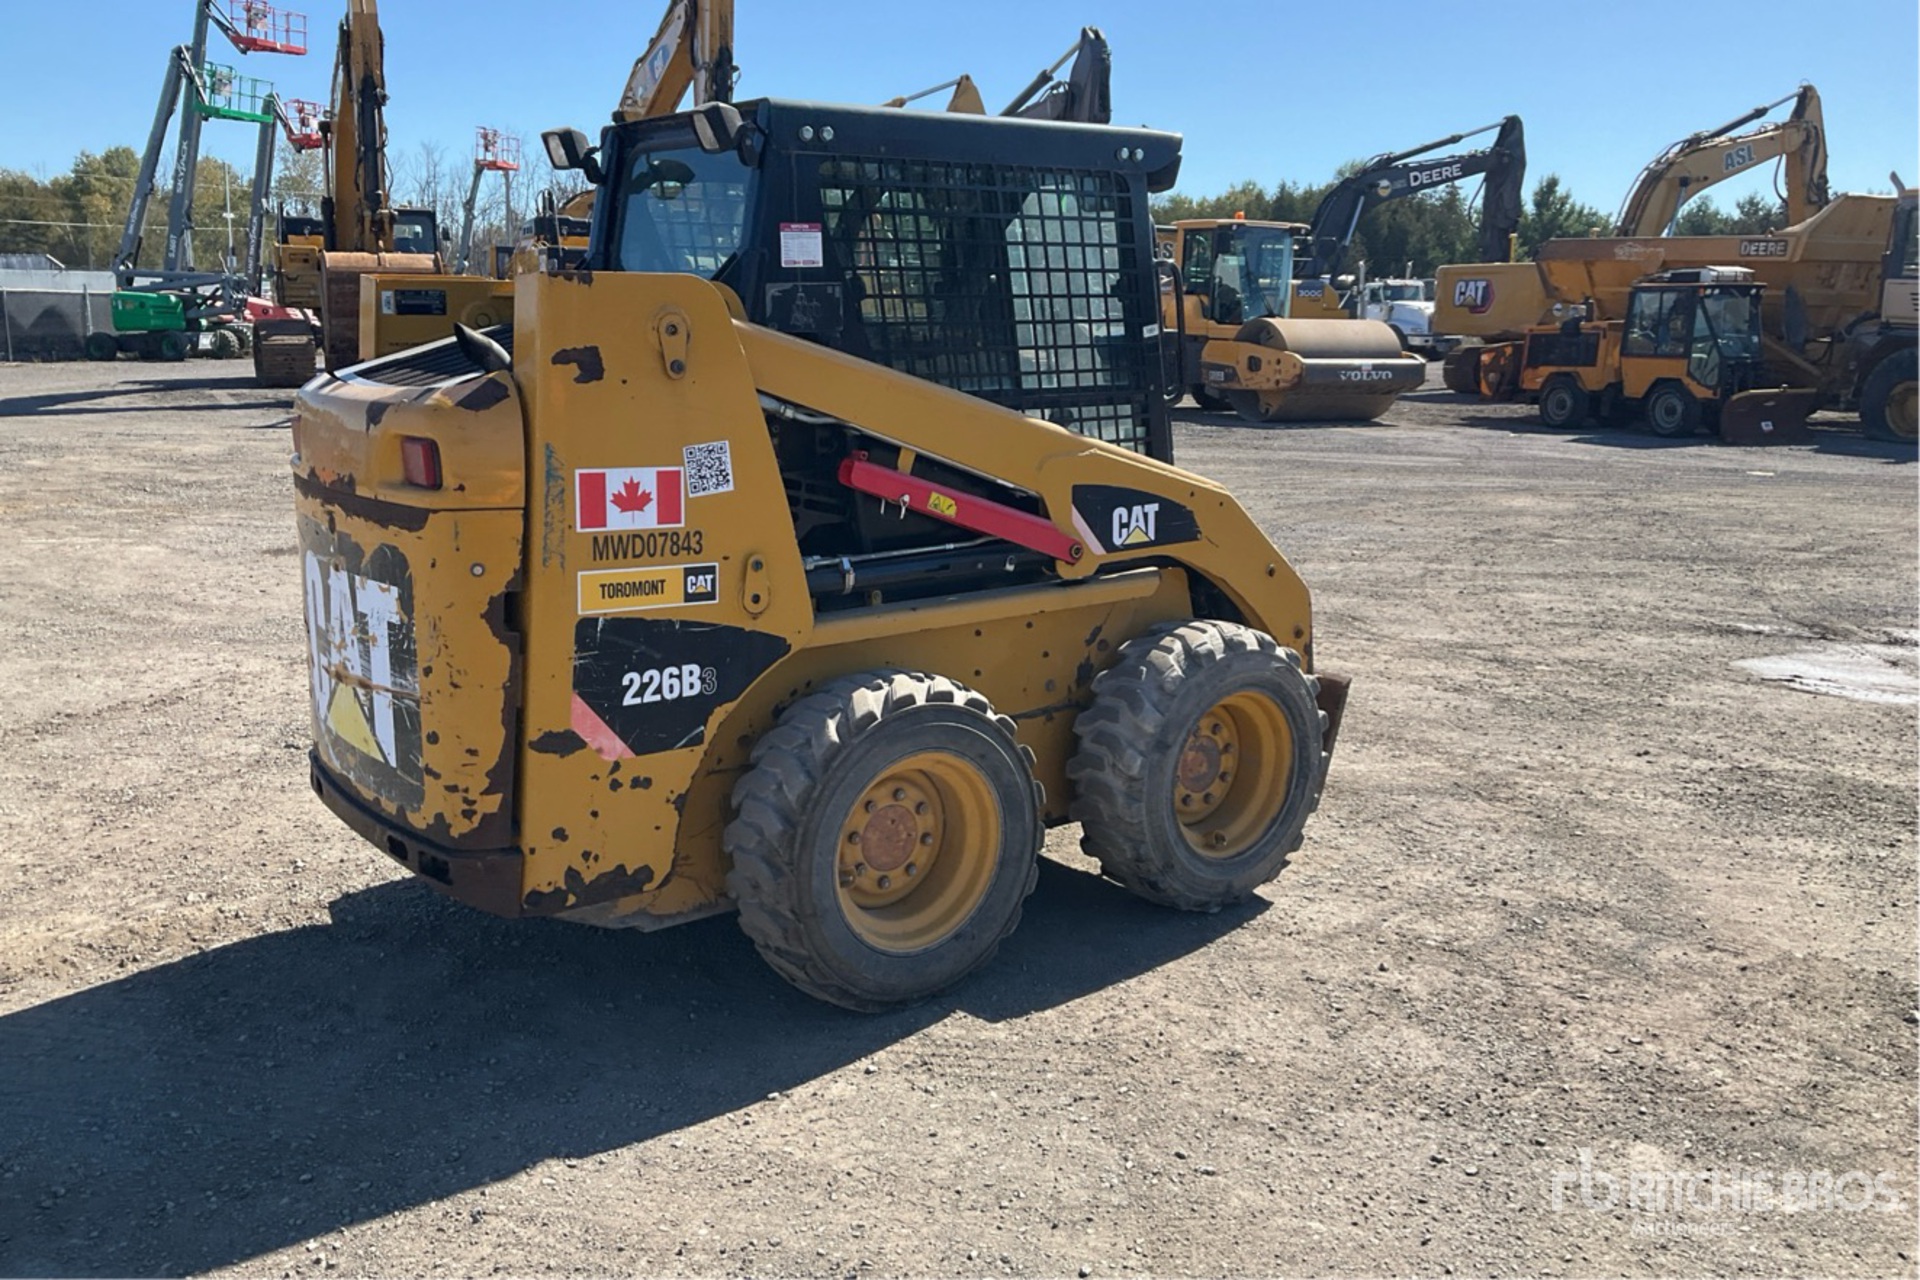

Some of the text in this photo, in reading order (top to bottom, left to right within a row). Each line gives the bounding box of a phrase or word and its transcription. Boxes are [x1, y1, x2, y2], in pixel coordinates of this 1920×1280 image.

[176, 140, 188, 194] SKYJACK
[1723, 145, 1757, 173] ASL
[1409, 163, 1462, 187] DEERE
[1740, 241, 1786, 256] DEERE
[1454, 280, 1487, 306] CAT
[1338, 370, 1393, 381] VOLVO
[1112, 503, 1159, 546] CAT
[592, 530, 703, 562] MWD07843
[600, 574, 714, 600] TOROMONT CAT
[305, 550, 401, 769] CAT
